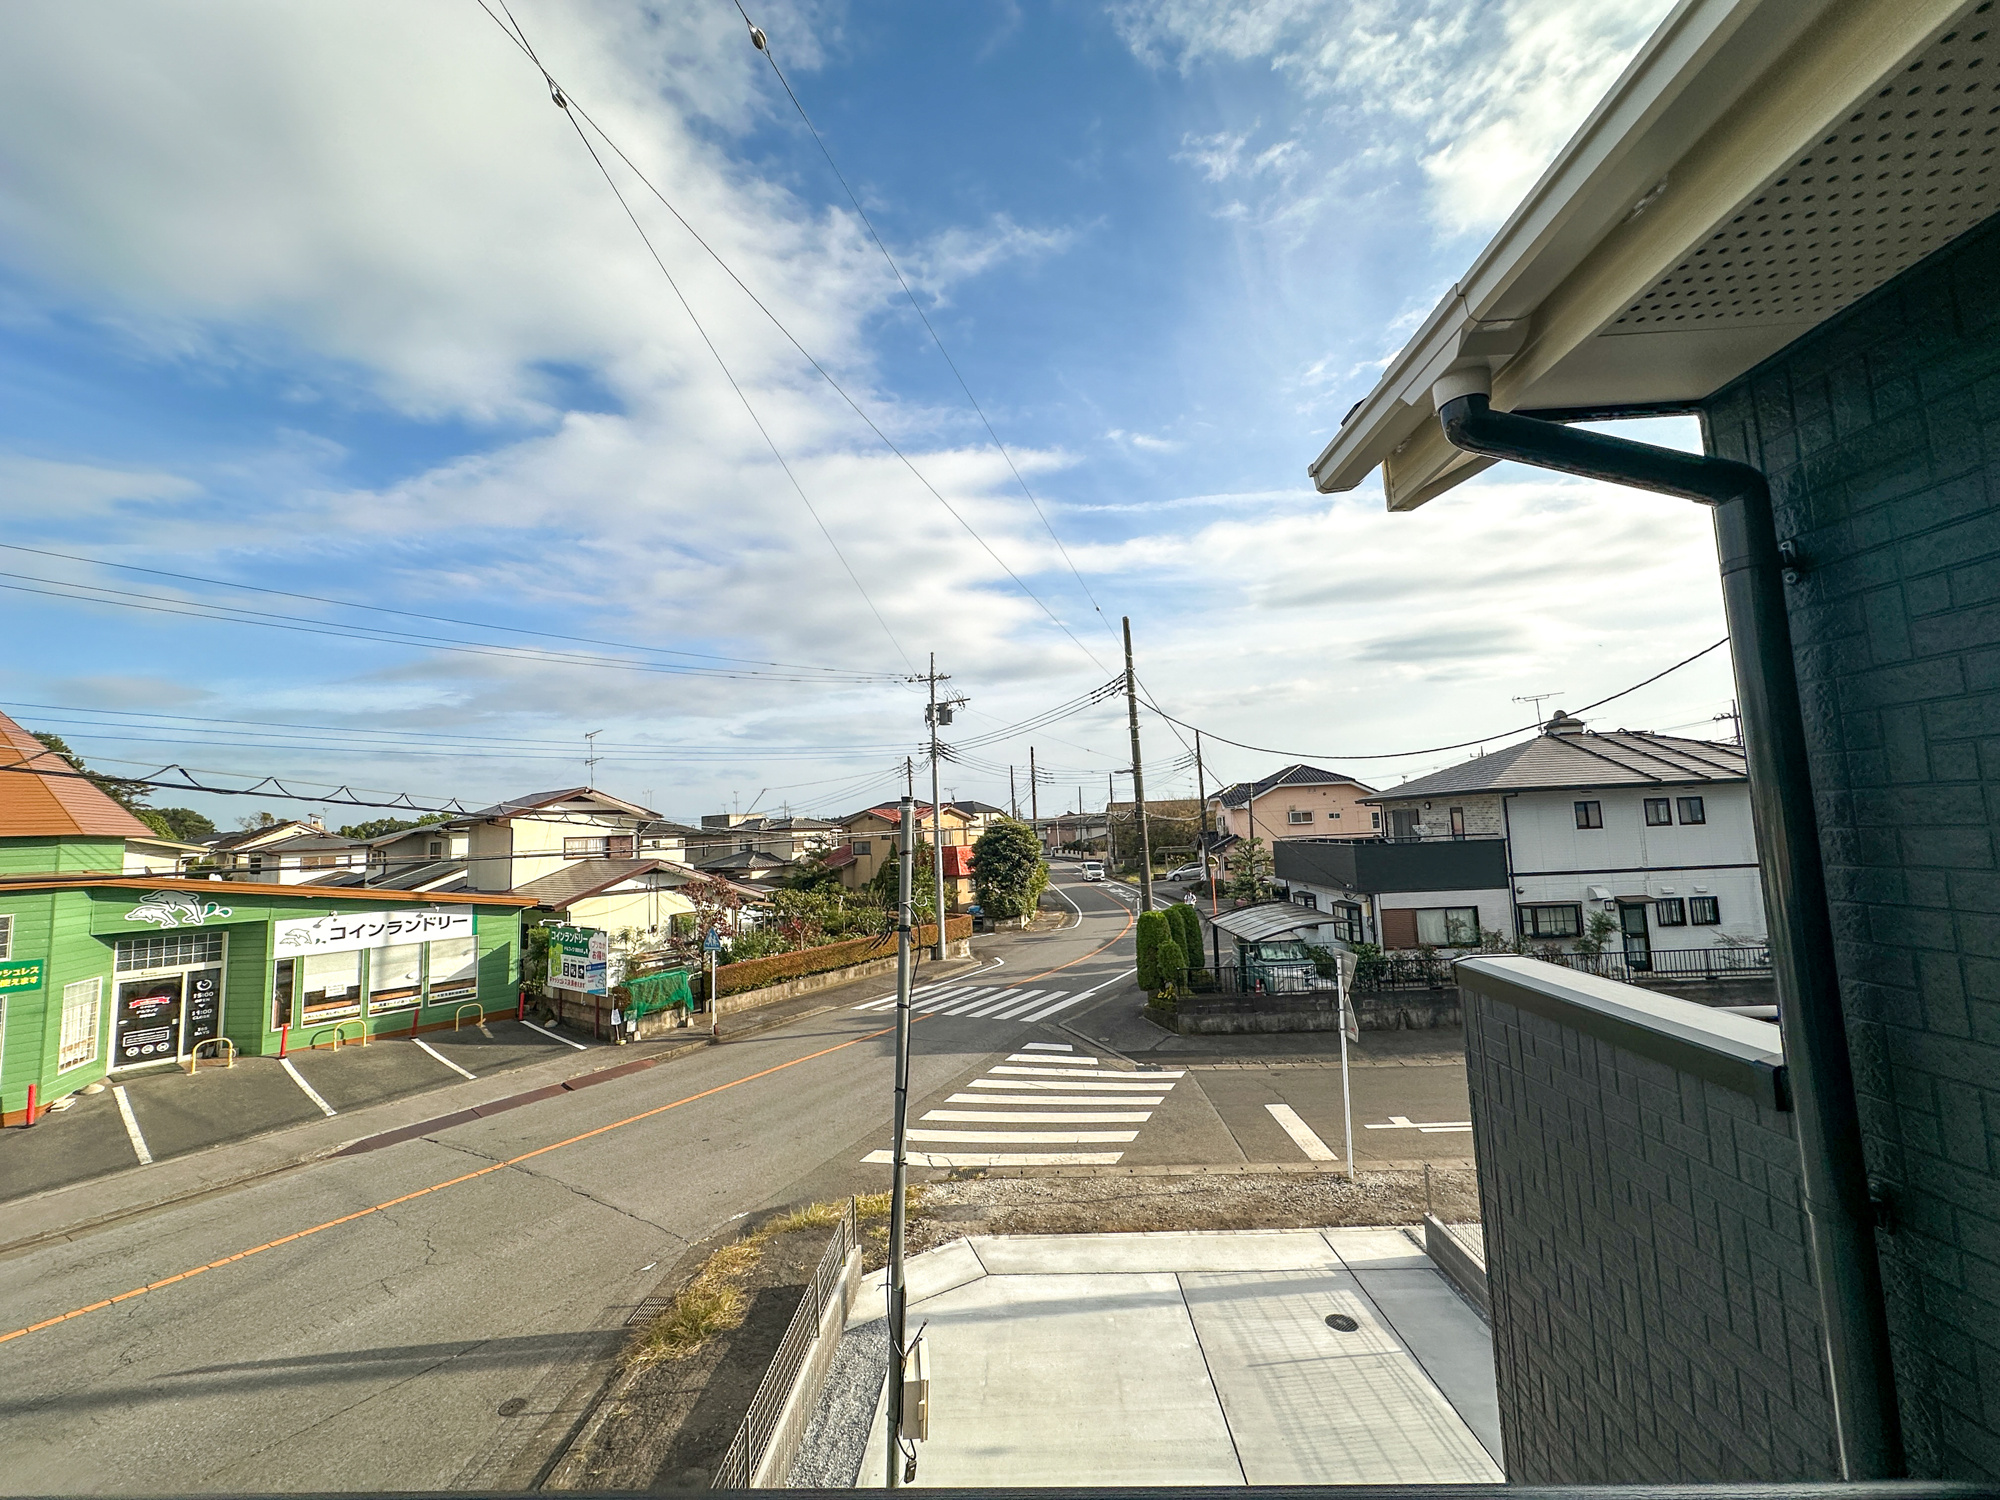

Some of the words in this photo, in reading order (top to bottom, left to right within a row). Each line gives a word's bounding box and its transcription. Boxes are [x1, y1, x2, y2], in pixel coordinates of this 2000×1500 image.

[330, 915, 468, 941] コインランドリー
[551, 931, 588, 943] コインランドリー
